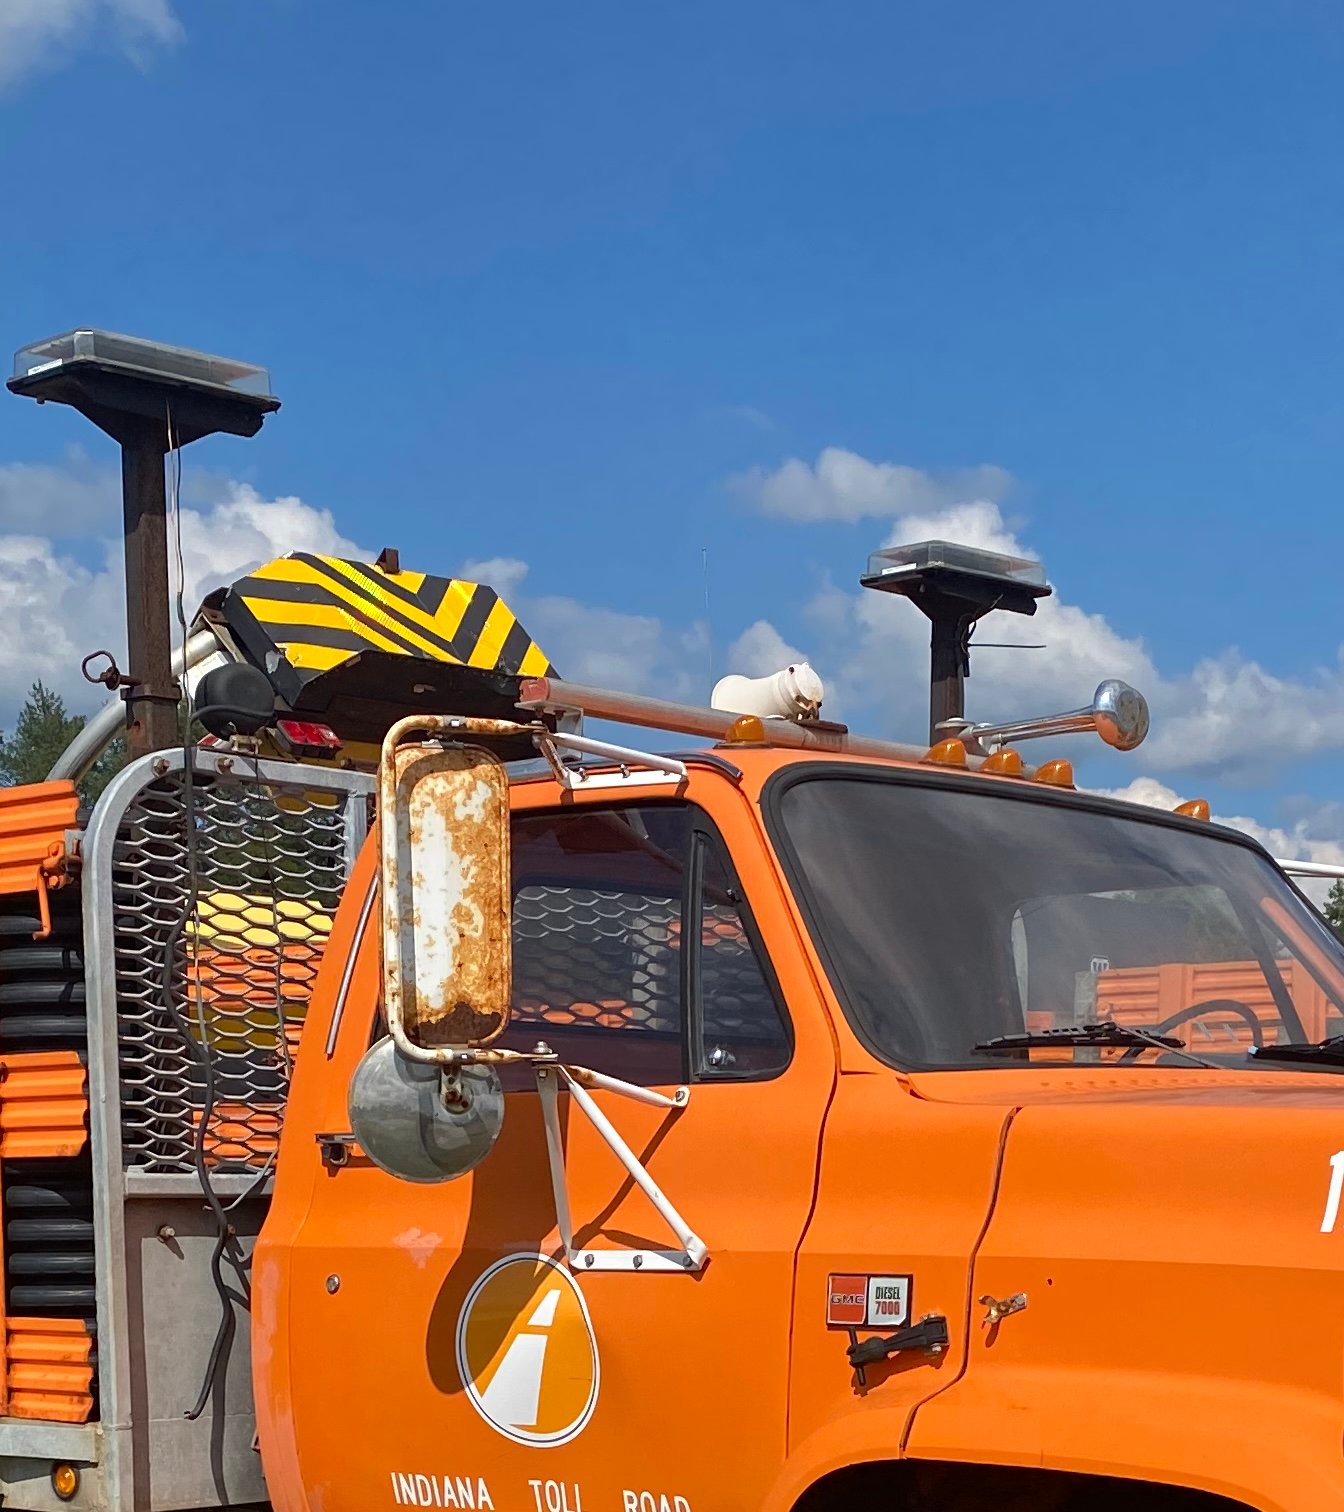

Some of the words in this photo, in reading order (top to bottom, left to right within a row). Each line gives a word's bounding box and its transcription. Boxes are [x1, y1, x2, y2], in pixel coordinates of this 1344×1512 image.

[830, 1292, 865, 1305] GMC
[875, 1286, 900, 1300] DIESEL
[875, 1301, 900, 1315] 7000
[391, 1472, 495, 1511] INDIANA
